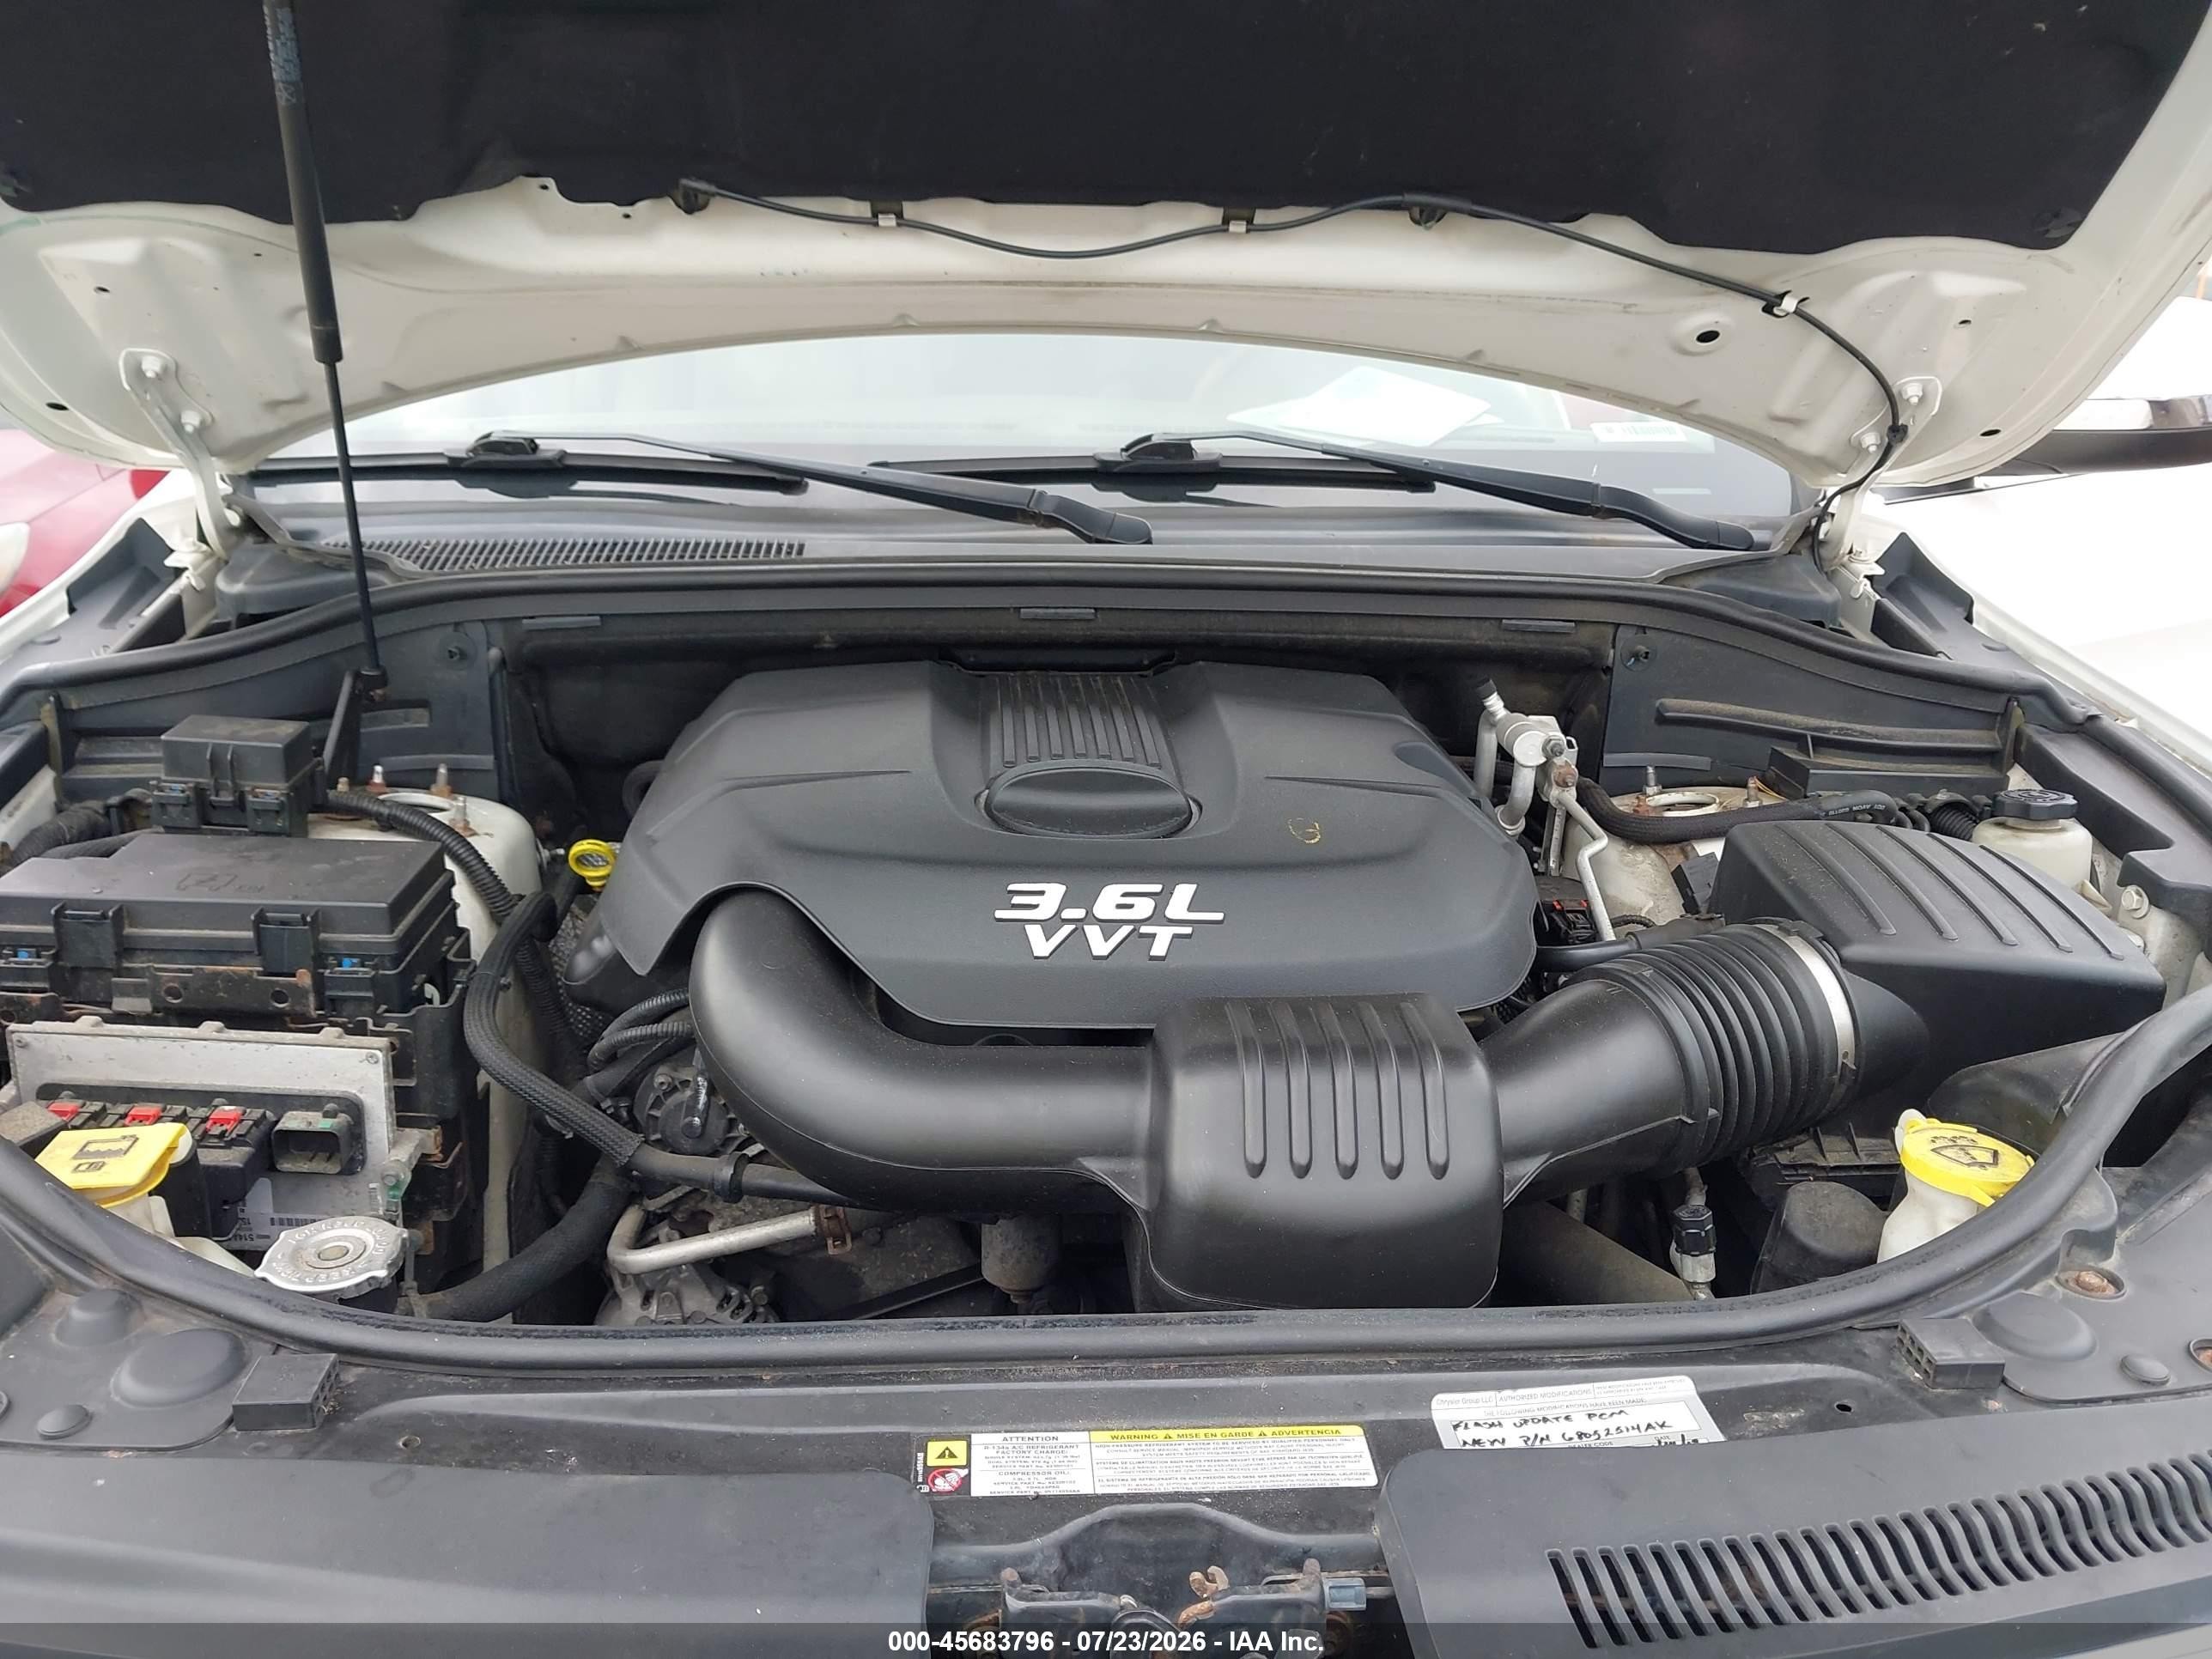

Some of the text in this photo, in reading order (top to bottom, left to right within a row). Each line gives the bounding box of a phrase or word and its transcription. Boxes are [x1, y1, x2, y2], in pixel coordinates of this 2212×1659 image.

[994, 883, 1225, 923] 3.6L
[1024, 924, 1194, 960] VVT
[1499, 1393, 1538, 1401] AUTHORIZED
[1540, 1389, 1592, 1399] MODIFICATIONS
[1452, 1410, 1631, 1432] FLASH UPDATE PCM
[1462, 1437, 1506, 1448] NEW
[1518, 1433, 1552, 1446] P/N
